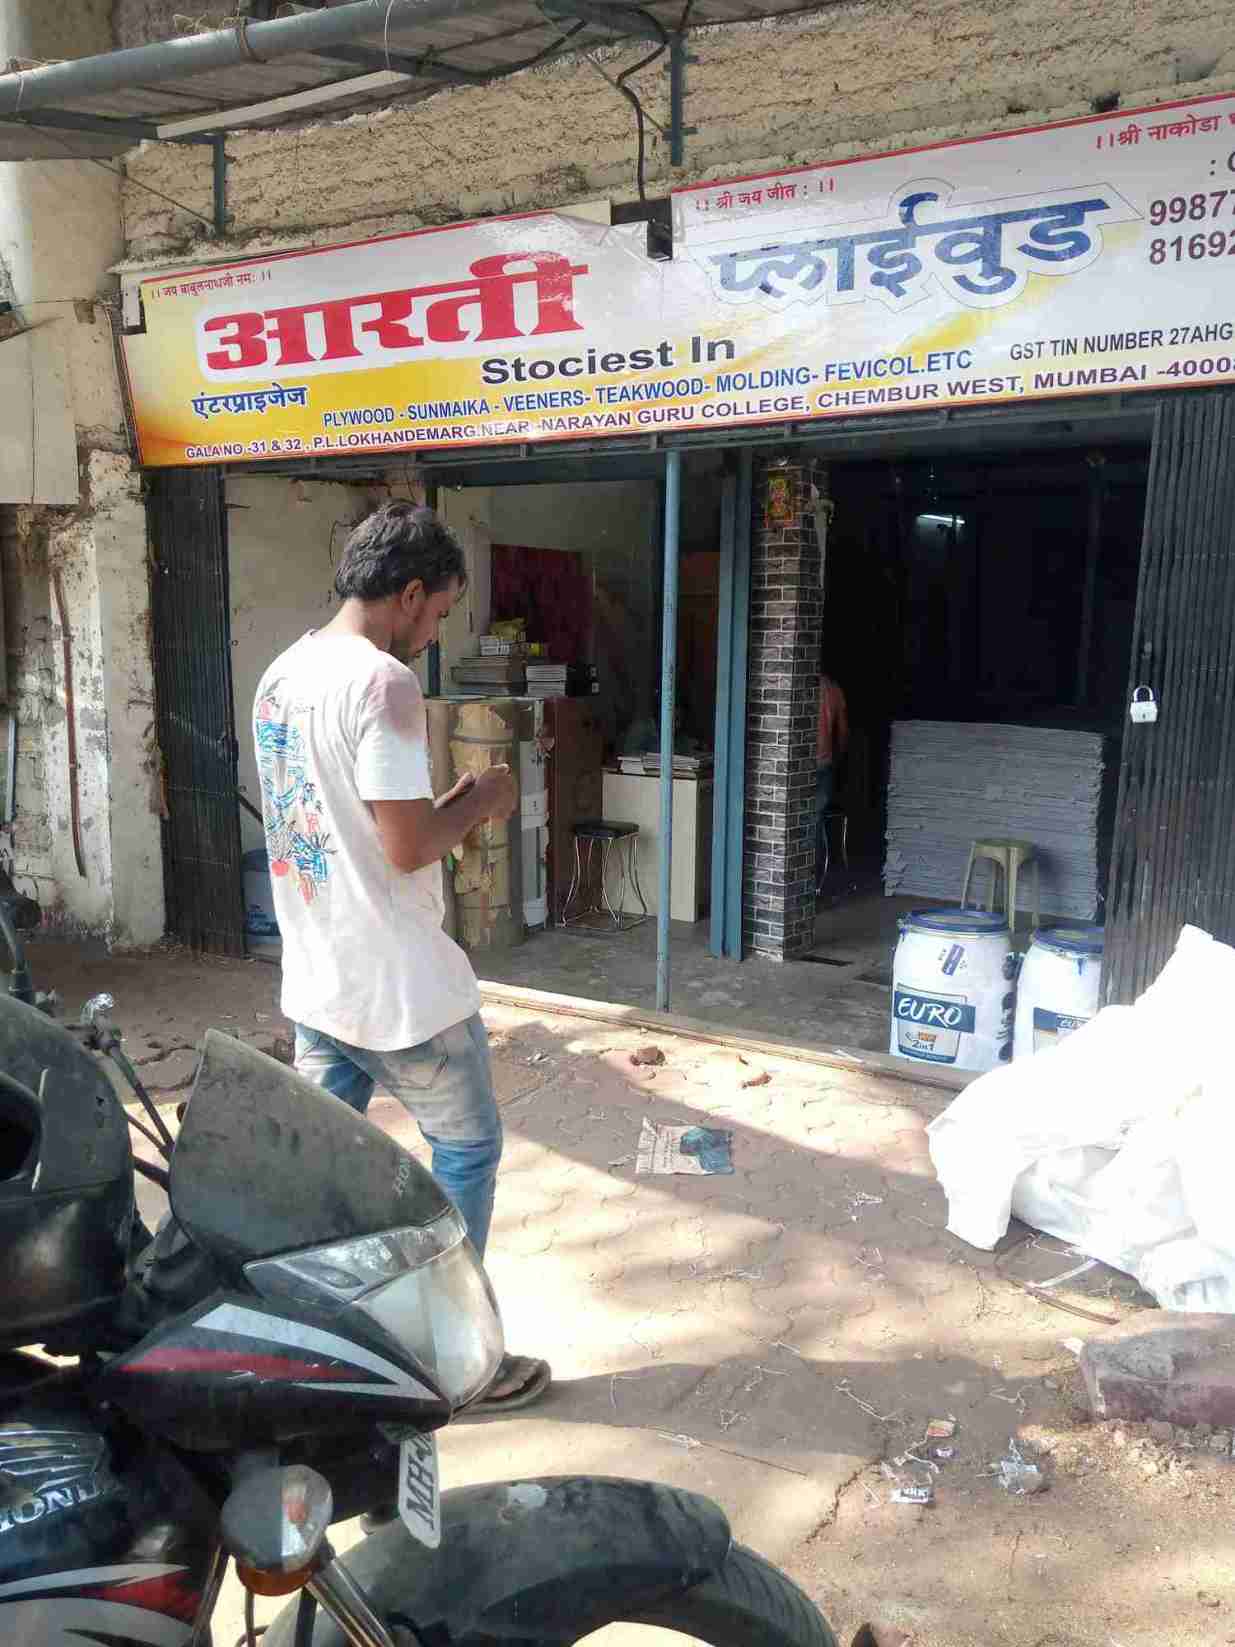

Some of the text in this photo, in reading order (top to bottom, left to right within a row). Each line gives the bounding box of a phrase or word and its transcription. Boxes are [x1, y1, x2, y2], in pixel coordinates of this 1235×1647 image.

[1147, 113, 1222, 140] नाकोडा
[738, 190, 763, 205] जय
[767, 181, 797, 201] जीत
[708, 191, 1111, 298] प्लाईवुड
[203, 250, 588, 371] आरती
[482, 335, 735, 385] Stociest In
[1010, 341, 1045, 360] GST
[1049, 337, 1078, 357] TIN
[1082, 330, 1164, 354] NUMBER
[191, 382, 308, 419] एंटरप्राइजेज
[271, 439, 282, 451] &
[637, 404, 695, 425] GURU
[701, 395, 811, 419] COLLEGE,
[818, 383, 939, 408] CHEMBUR
[947, 376, 1025, 397] WEST,
[1033, 364, 1148, 390] MUMBAI
[323, 407, 394, 427] PLYWOOD
[407, 399, 490, 420] SUNMAIKA
[898, 997, 964, 1028] EURO
